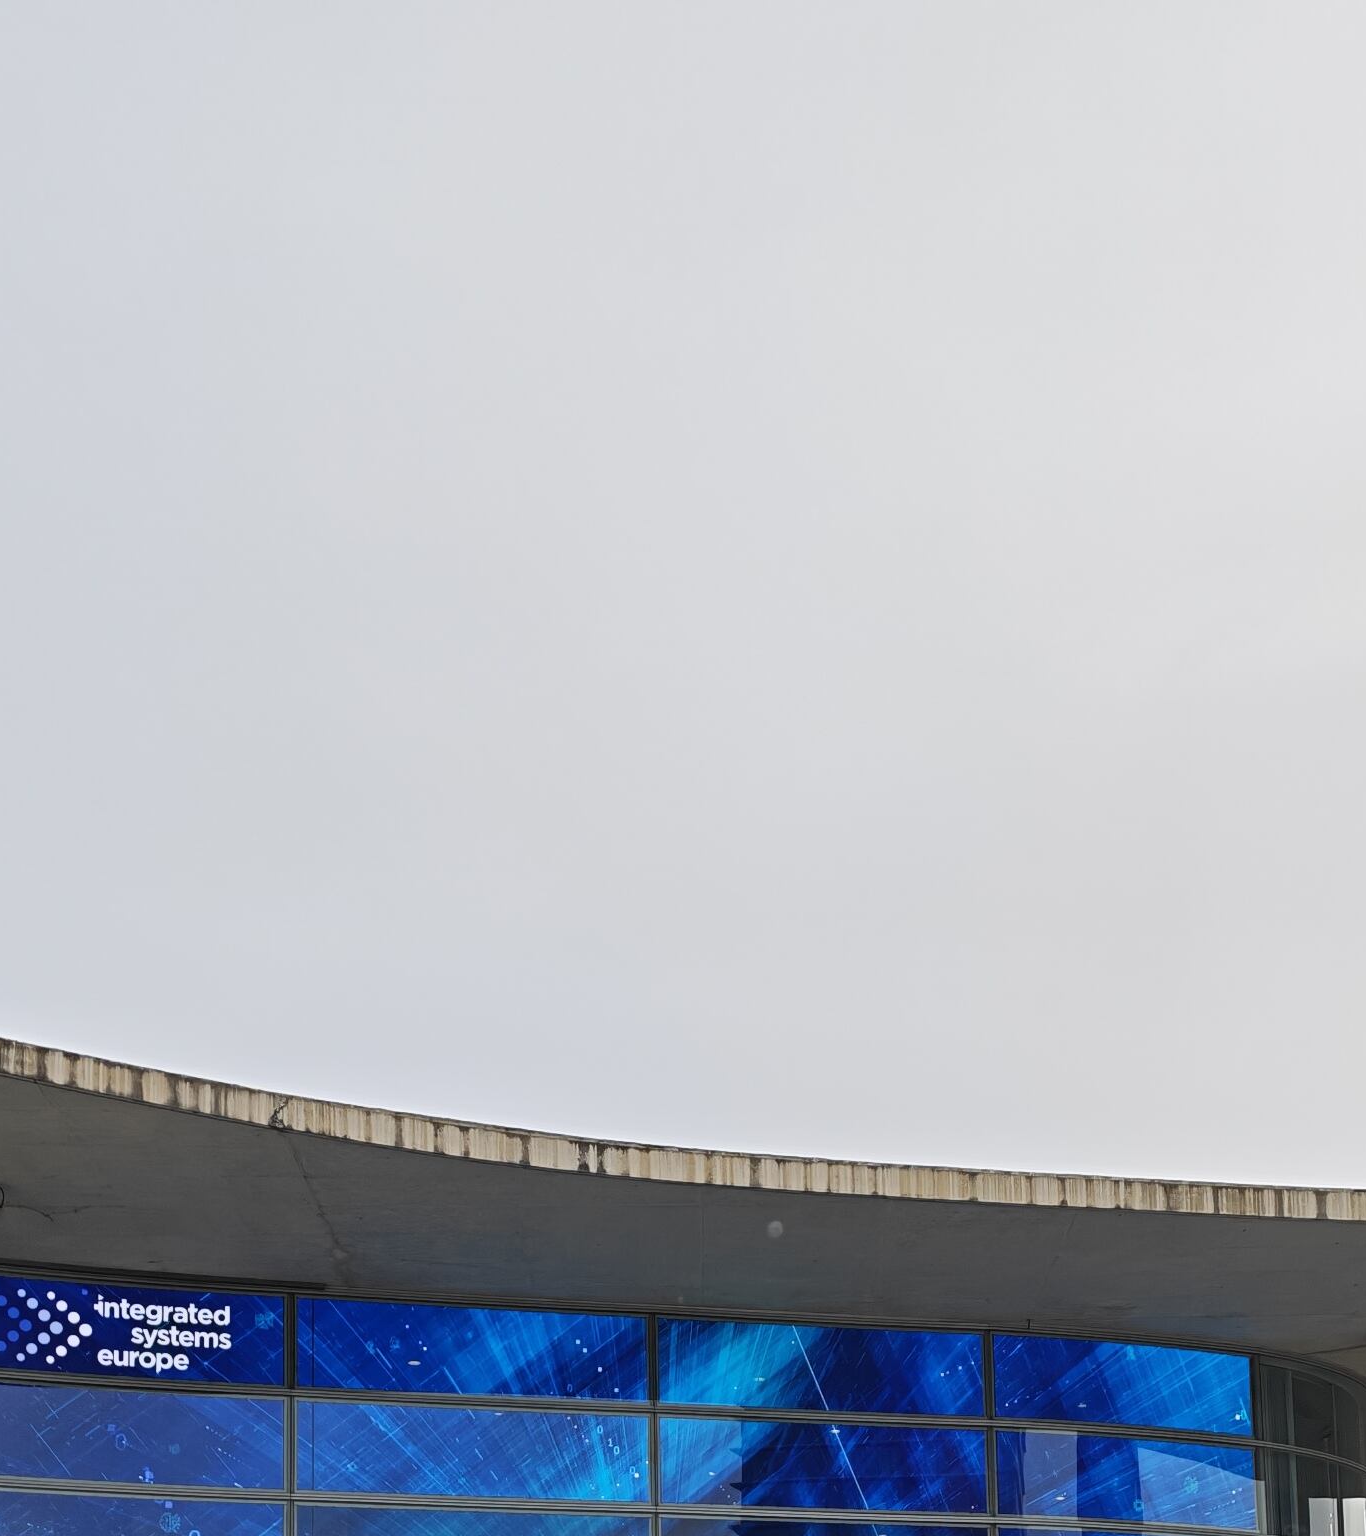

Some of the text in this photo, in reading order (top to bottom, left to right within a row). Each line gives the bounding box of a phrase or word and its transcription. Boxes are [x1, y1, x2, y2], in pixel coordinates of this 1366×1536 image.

[93, 1294, 231, 1326] integrated
[130, 1325, 233, 1350] systems
[97, 1348, 190, 1375] europe
